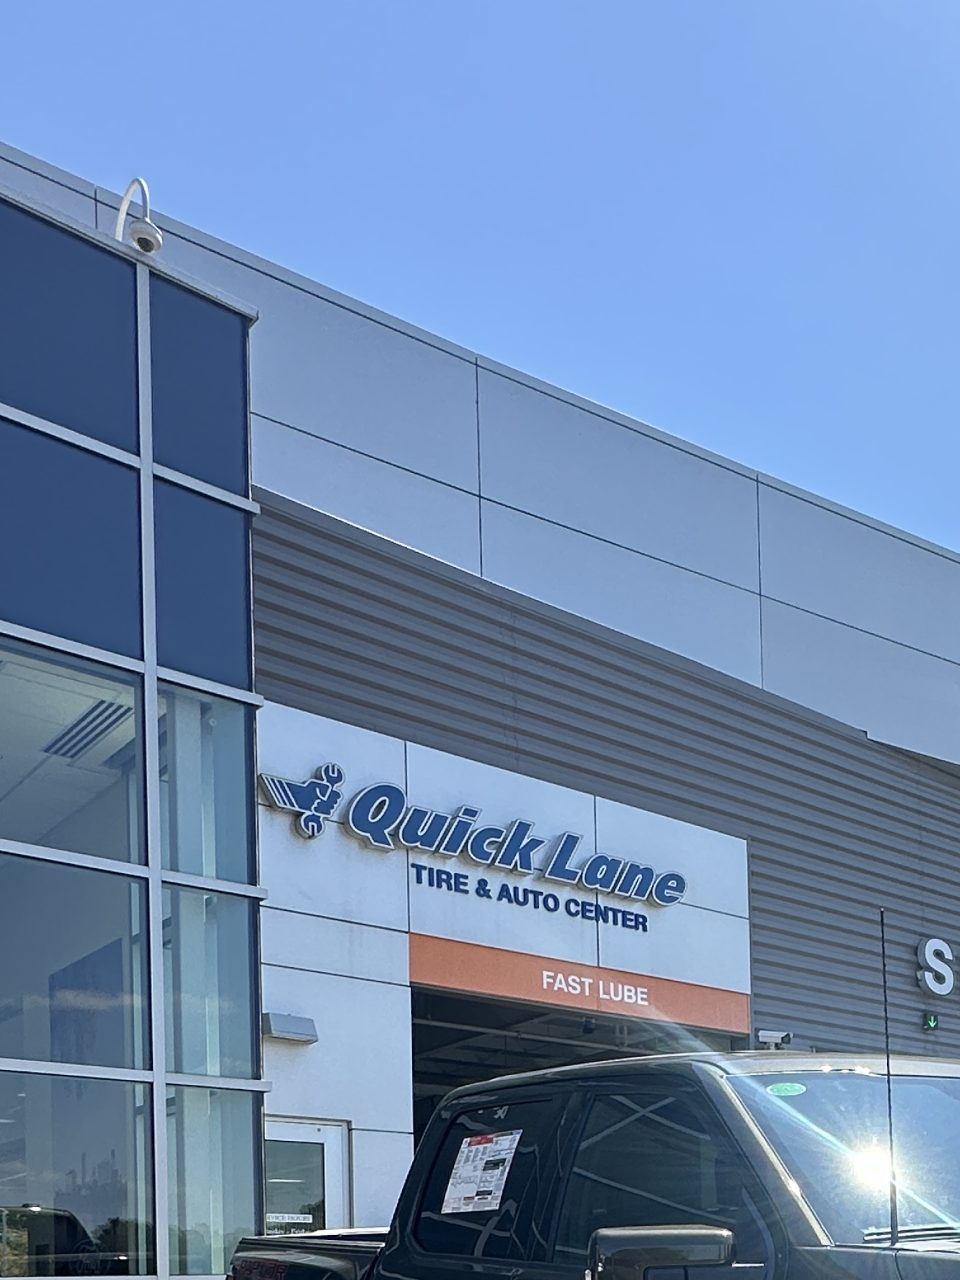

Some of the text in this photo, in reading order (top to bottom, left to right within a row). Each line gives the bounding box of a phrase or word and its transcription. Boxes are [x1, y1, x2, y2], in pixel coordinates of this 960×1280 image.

[348, 783, 688, 907] Quick Lane
[411, 863, 649, 932] TIRE & AUTO CENTER
[543, 969, 649, 1006] FAST LUBE
